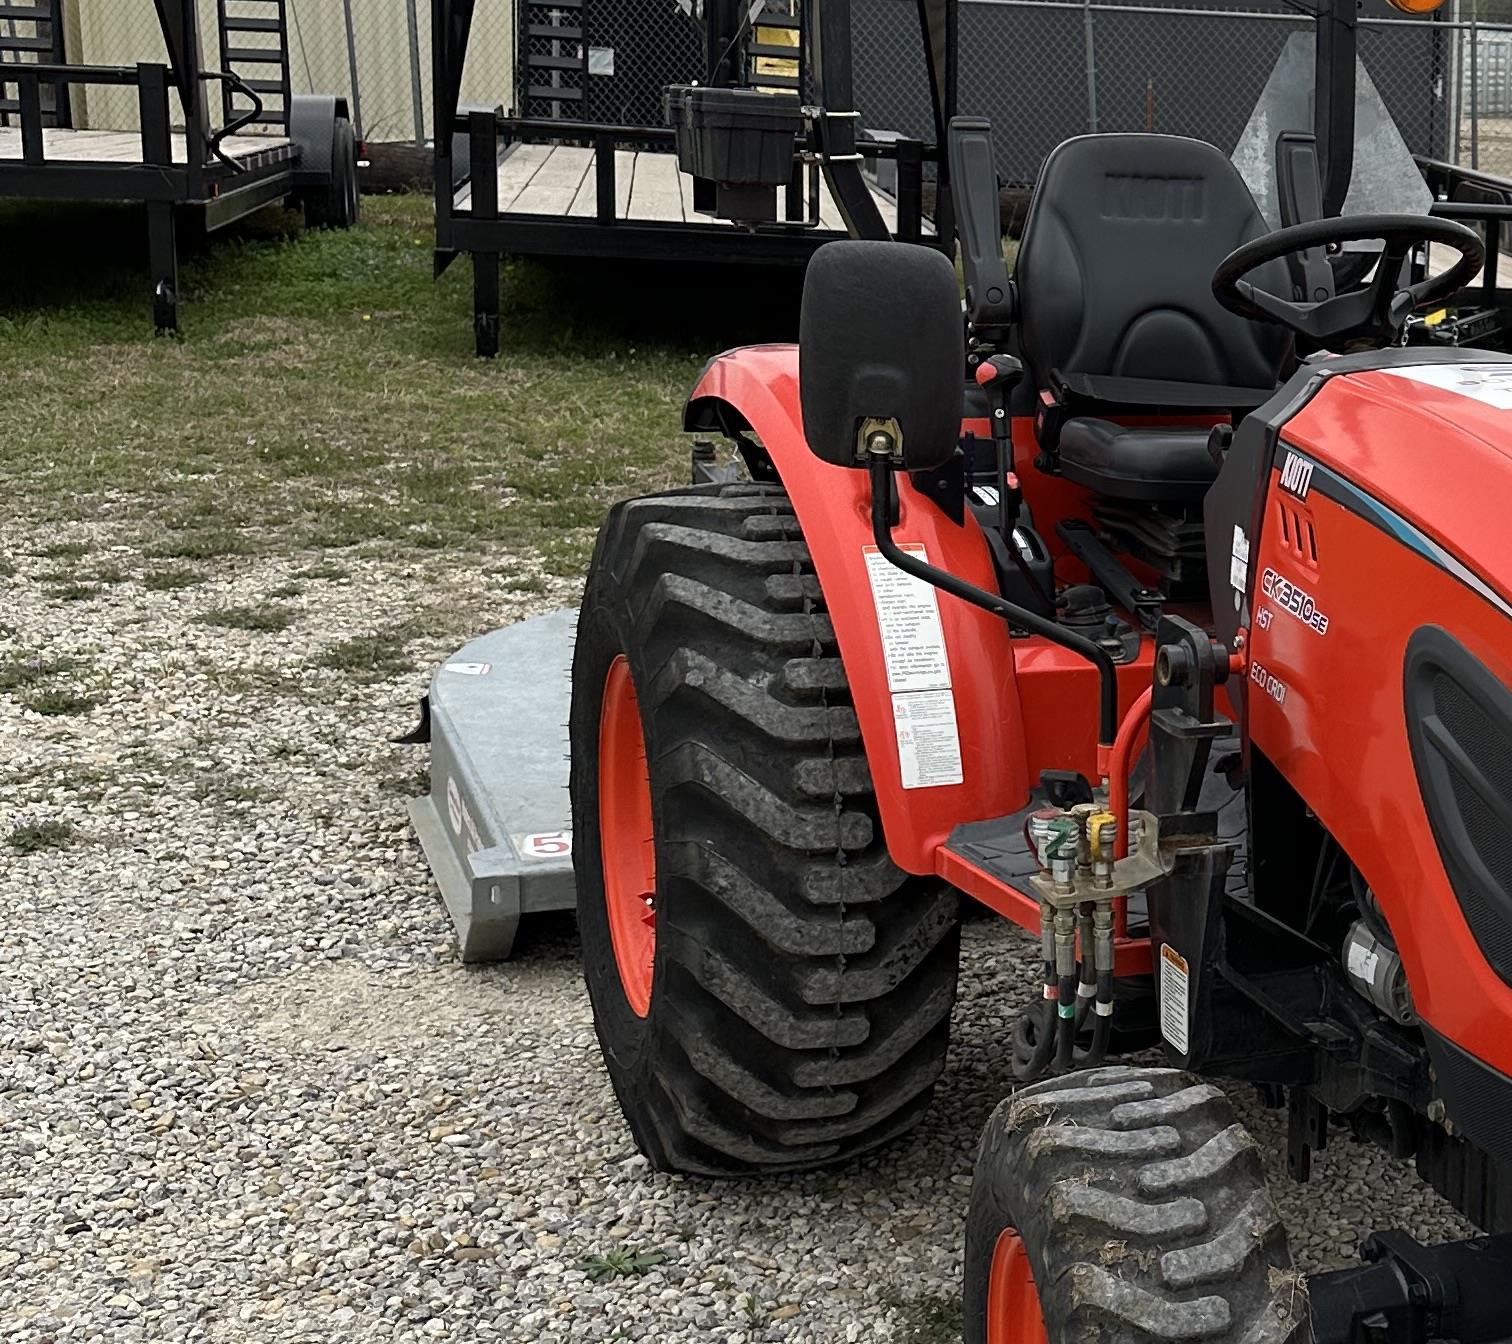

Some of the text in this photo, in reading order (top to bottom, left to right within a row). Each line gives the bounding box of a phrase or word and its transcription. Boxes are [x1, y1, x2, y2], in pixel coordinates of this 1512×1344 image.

[1280, 452, 1314, 497] KIOTI
[1255, 606, 1274, 632] HST
[1250, 661, 1267, 688] ECO
